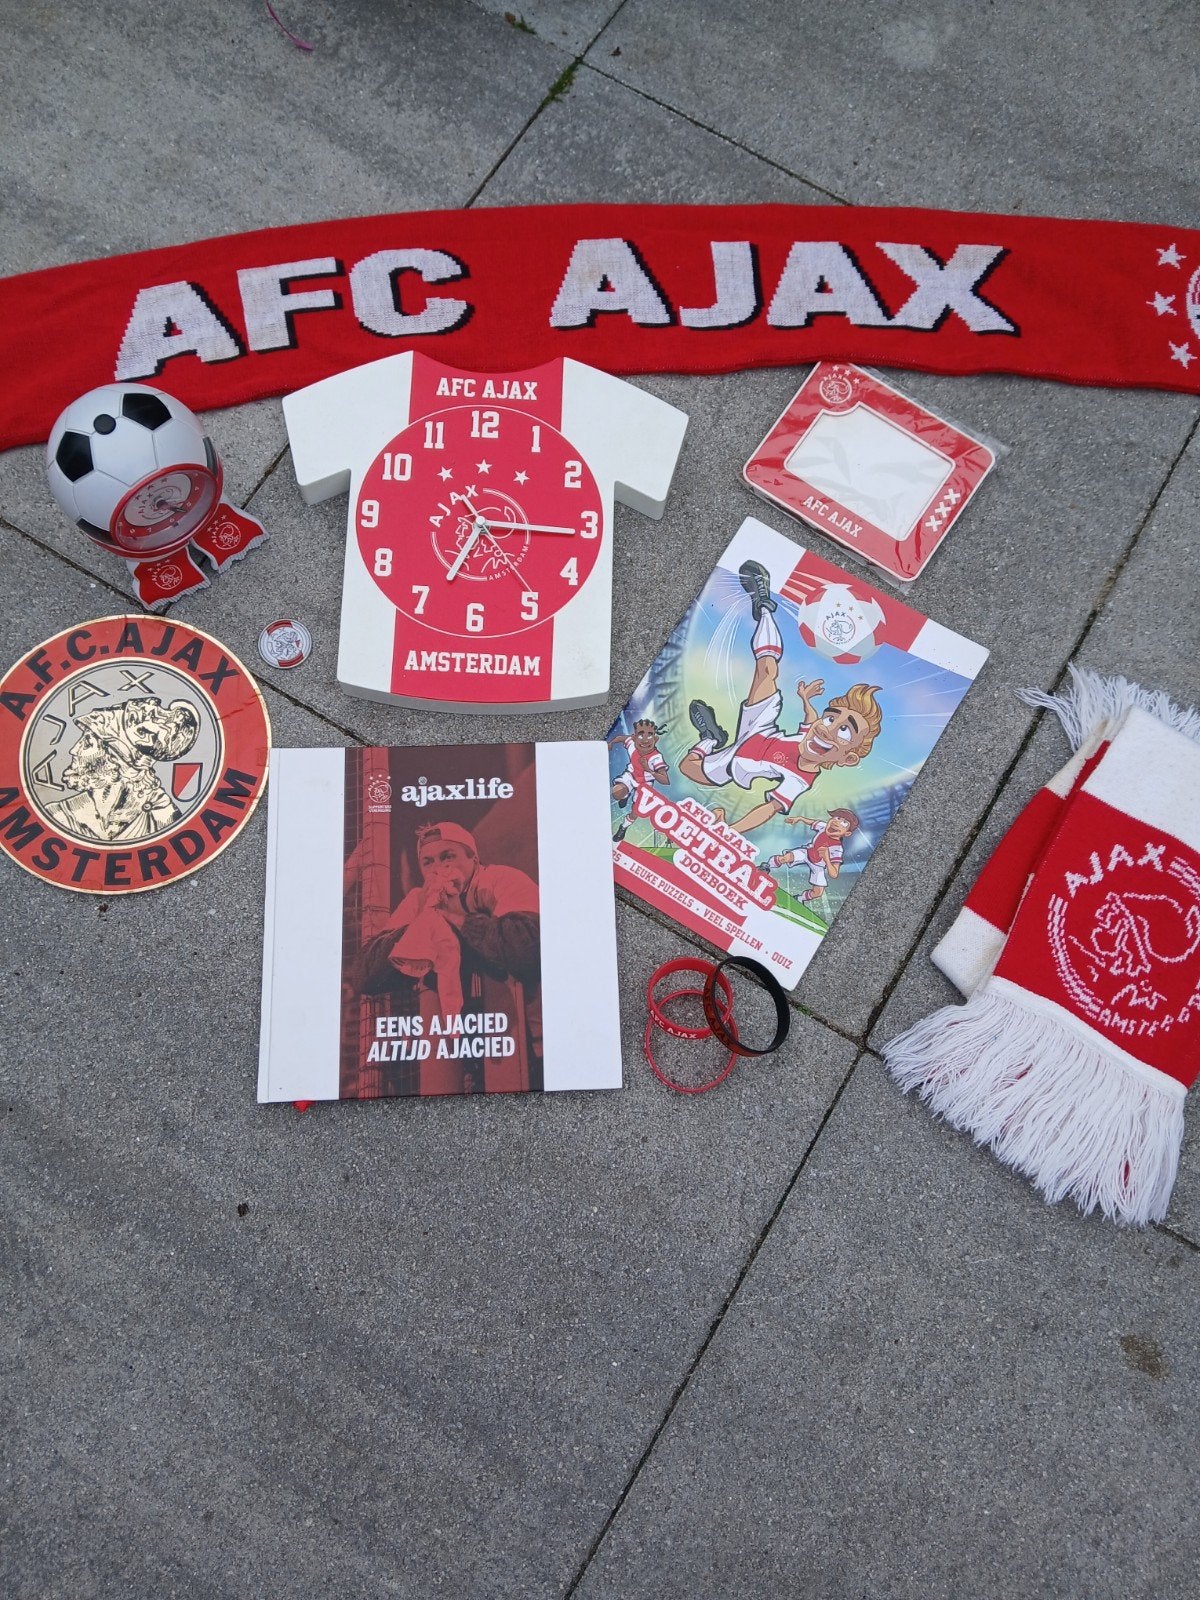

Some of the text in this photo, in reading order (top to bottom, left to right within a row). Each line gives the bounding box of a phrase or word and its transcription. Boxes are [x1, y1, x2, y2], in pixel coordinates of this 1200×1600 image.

[114, 237, 1021, 382] AFC AJAX
[436, 377, 537, 401] AFC AJAX
[424, 421, 445, 449] 11
[471, 410, 499, 439] 12
[531, 425, 541, 453] 1
[382, 452, 412, 482] 10
[563, 460, 582, 488] 2
[360, 500, 380, 529] 9
[429, 484, 478, 528] AJAX
[802, 495, 863, 538] AFC AJAX
[580, 510, 598, 539] 3
[374, 548, 392, 577] 8
[561, 557, 579, 586] 4
[412, 585, 429, 614] 7
[520, 592, 539, 621] 5
[465, 603, 484, 632] 6
[826, 611, 846, 620] AJAX
[115, 622, 241, 696] AJAX
[404, 650, 541, 676] AMSTERDAM
[32, 669, 155, 792] AJAX
[401, 776, 514, 808] ajaxlife
[0, 768, 258, 886] AMSTERDAM
[681, 800, 756, 857] AFC AJAX
[637, 787, 775, 907] VOETBAL
[679, 854, 748, 911] DOEBOEK
[1064, 842, 1166, 898] AJAX
[629, 863, 657, 886] LEUKE
[658, 879, 694, 908] PUZZELS
[704, 908, 725, 928] VEEL
[727, 923, 763, 951] SPELLEN
[771, 951, 793, 970] QUIZ
[1099, 978, 1200, 1037] AMSTERDA
[376, 1013, 508, 1038] EENS AJACIED
[650, 1010, 697, 1039] AFC AJAX
[367, 1036, 515, 1062] ALTIJD AJACIED
